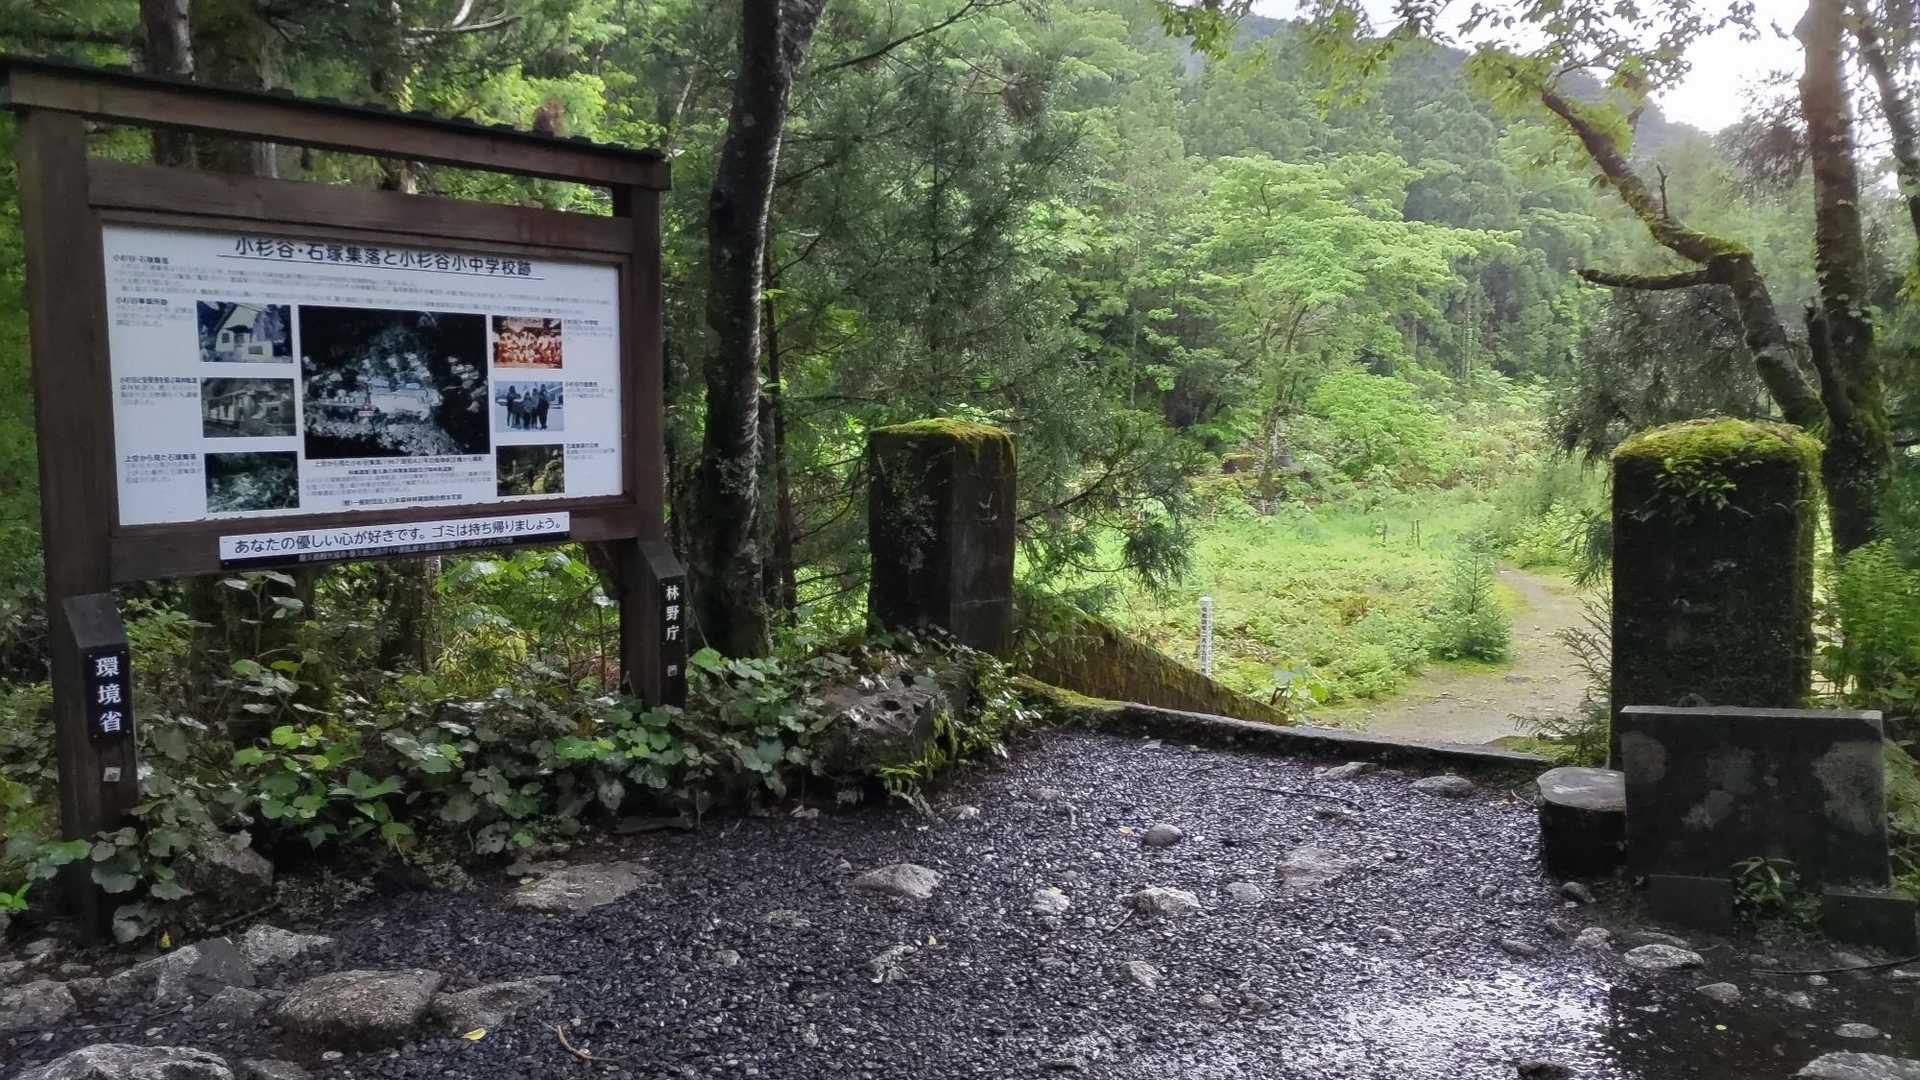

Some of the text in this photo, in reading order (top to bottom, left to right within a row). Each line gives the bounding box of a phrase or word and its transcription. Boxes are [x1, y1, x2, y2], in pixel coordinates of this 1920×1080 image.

[235, 237, 532, 276] 小杉谷・石塚集落と小杉谷小中学校跡
[665, 584, 680, 641] 林野庁
[95, 655, 123, 733] 環境省
